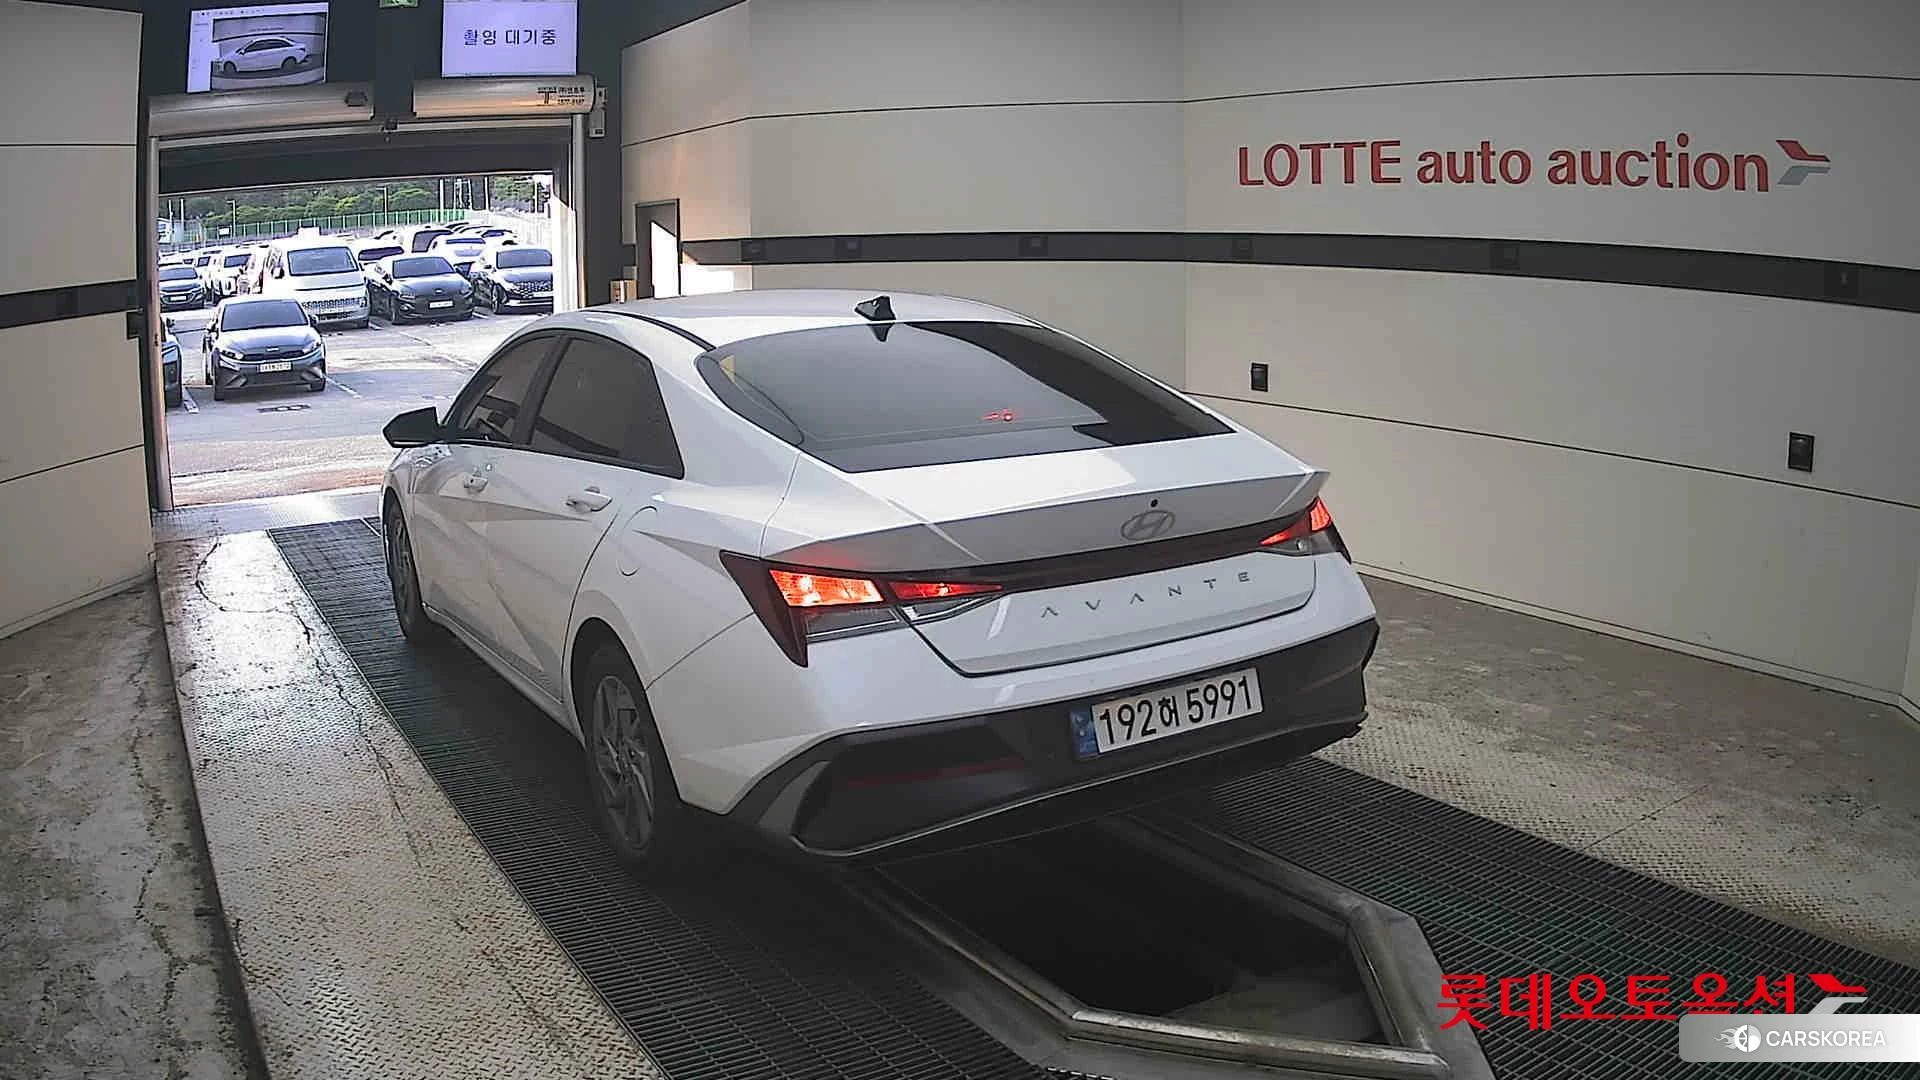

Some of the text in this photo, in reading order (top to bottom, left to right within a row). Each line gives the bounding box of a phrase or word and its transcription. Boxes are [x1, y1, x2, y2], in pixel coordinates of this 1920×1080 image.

[505, 29, 556, 46] 대기중
[1238, 133, 1769, 192] LOTTE auto auction
[1041, 571, 1251, 618] AVANTE
